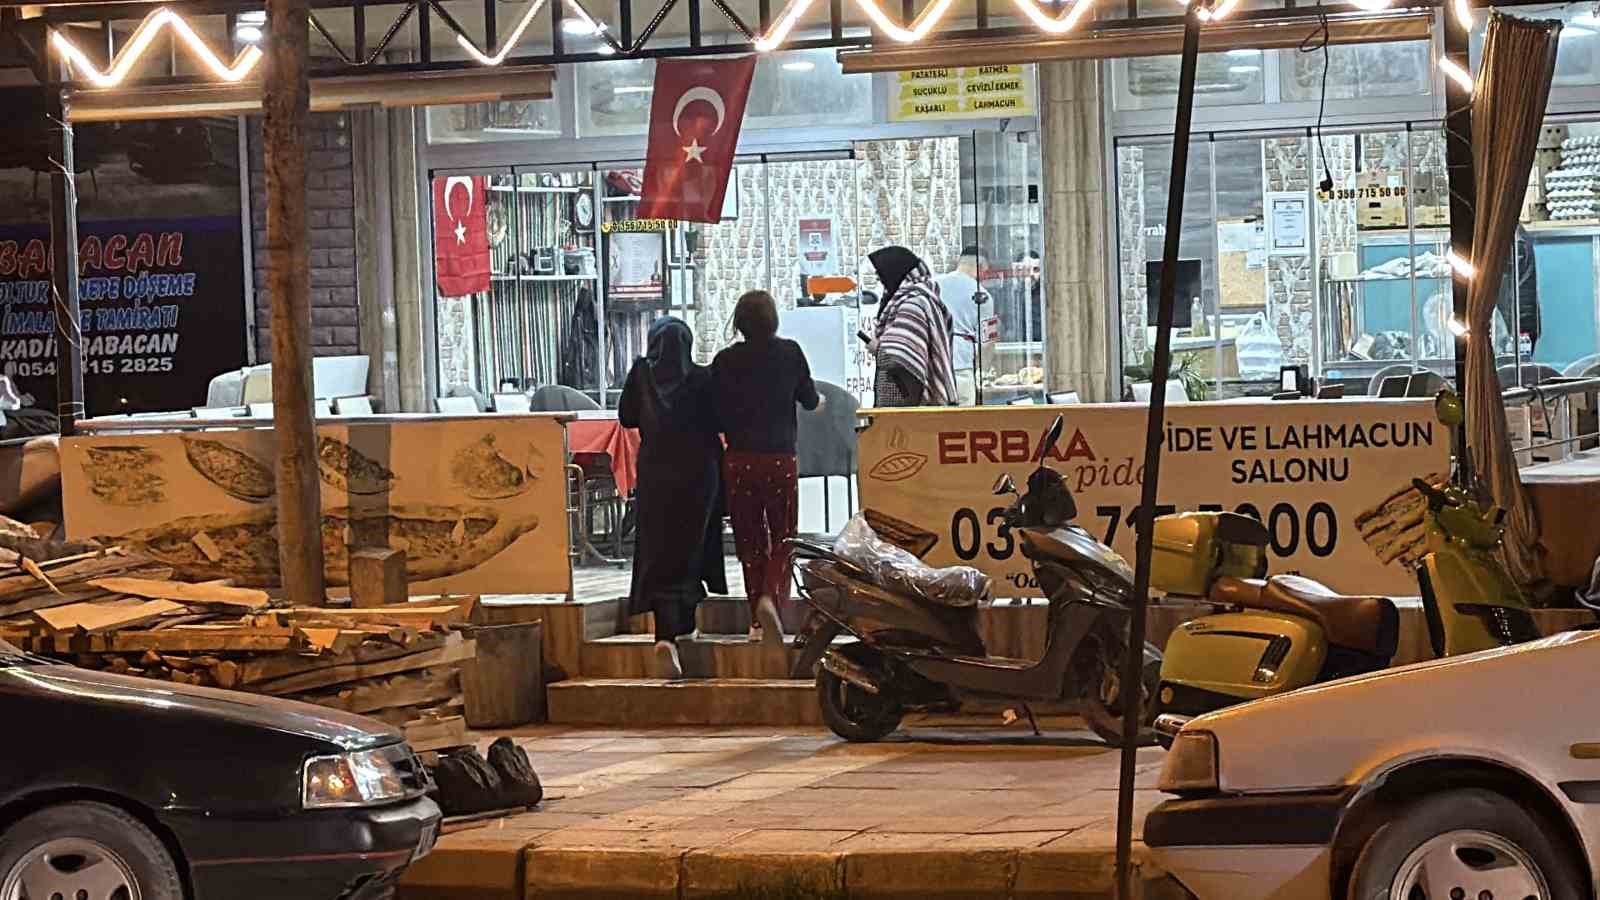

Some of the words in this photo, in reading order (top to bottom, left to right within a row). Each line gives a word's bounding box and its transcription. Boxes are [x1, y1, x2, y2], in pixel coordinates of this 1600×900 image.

[974, 99, 1016, 109] LAHMACUN
[0, 232, 183, 278] BAACAN
[123, 271, 196, 303] DÖŞEME
[2, 303, 56, 334] İMALA
[121, 357, 173, 373] 2825
[937, 428, 1096, 465] ERBAA
[1161, 420, 1213, 453] İDE
[1220, 426, 1257, 451] VE
[1265, 422, 1433, 450] LAHMACUN
[1231, 457, 1350, 485] SALONU
